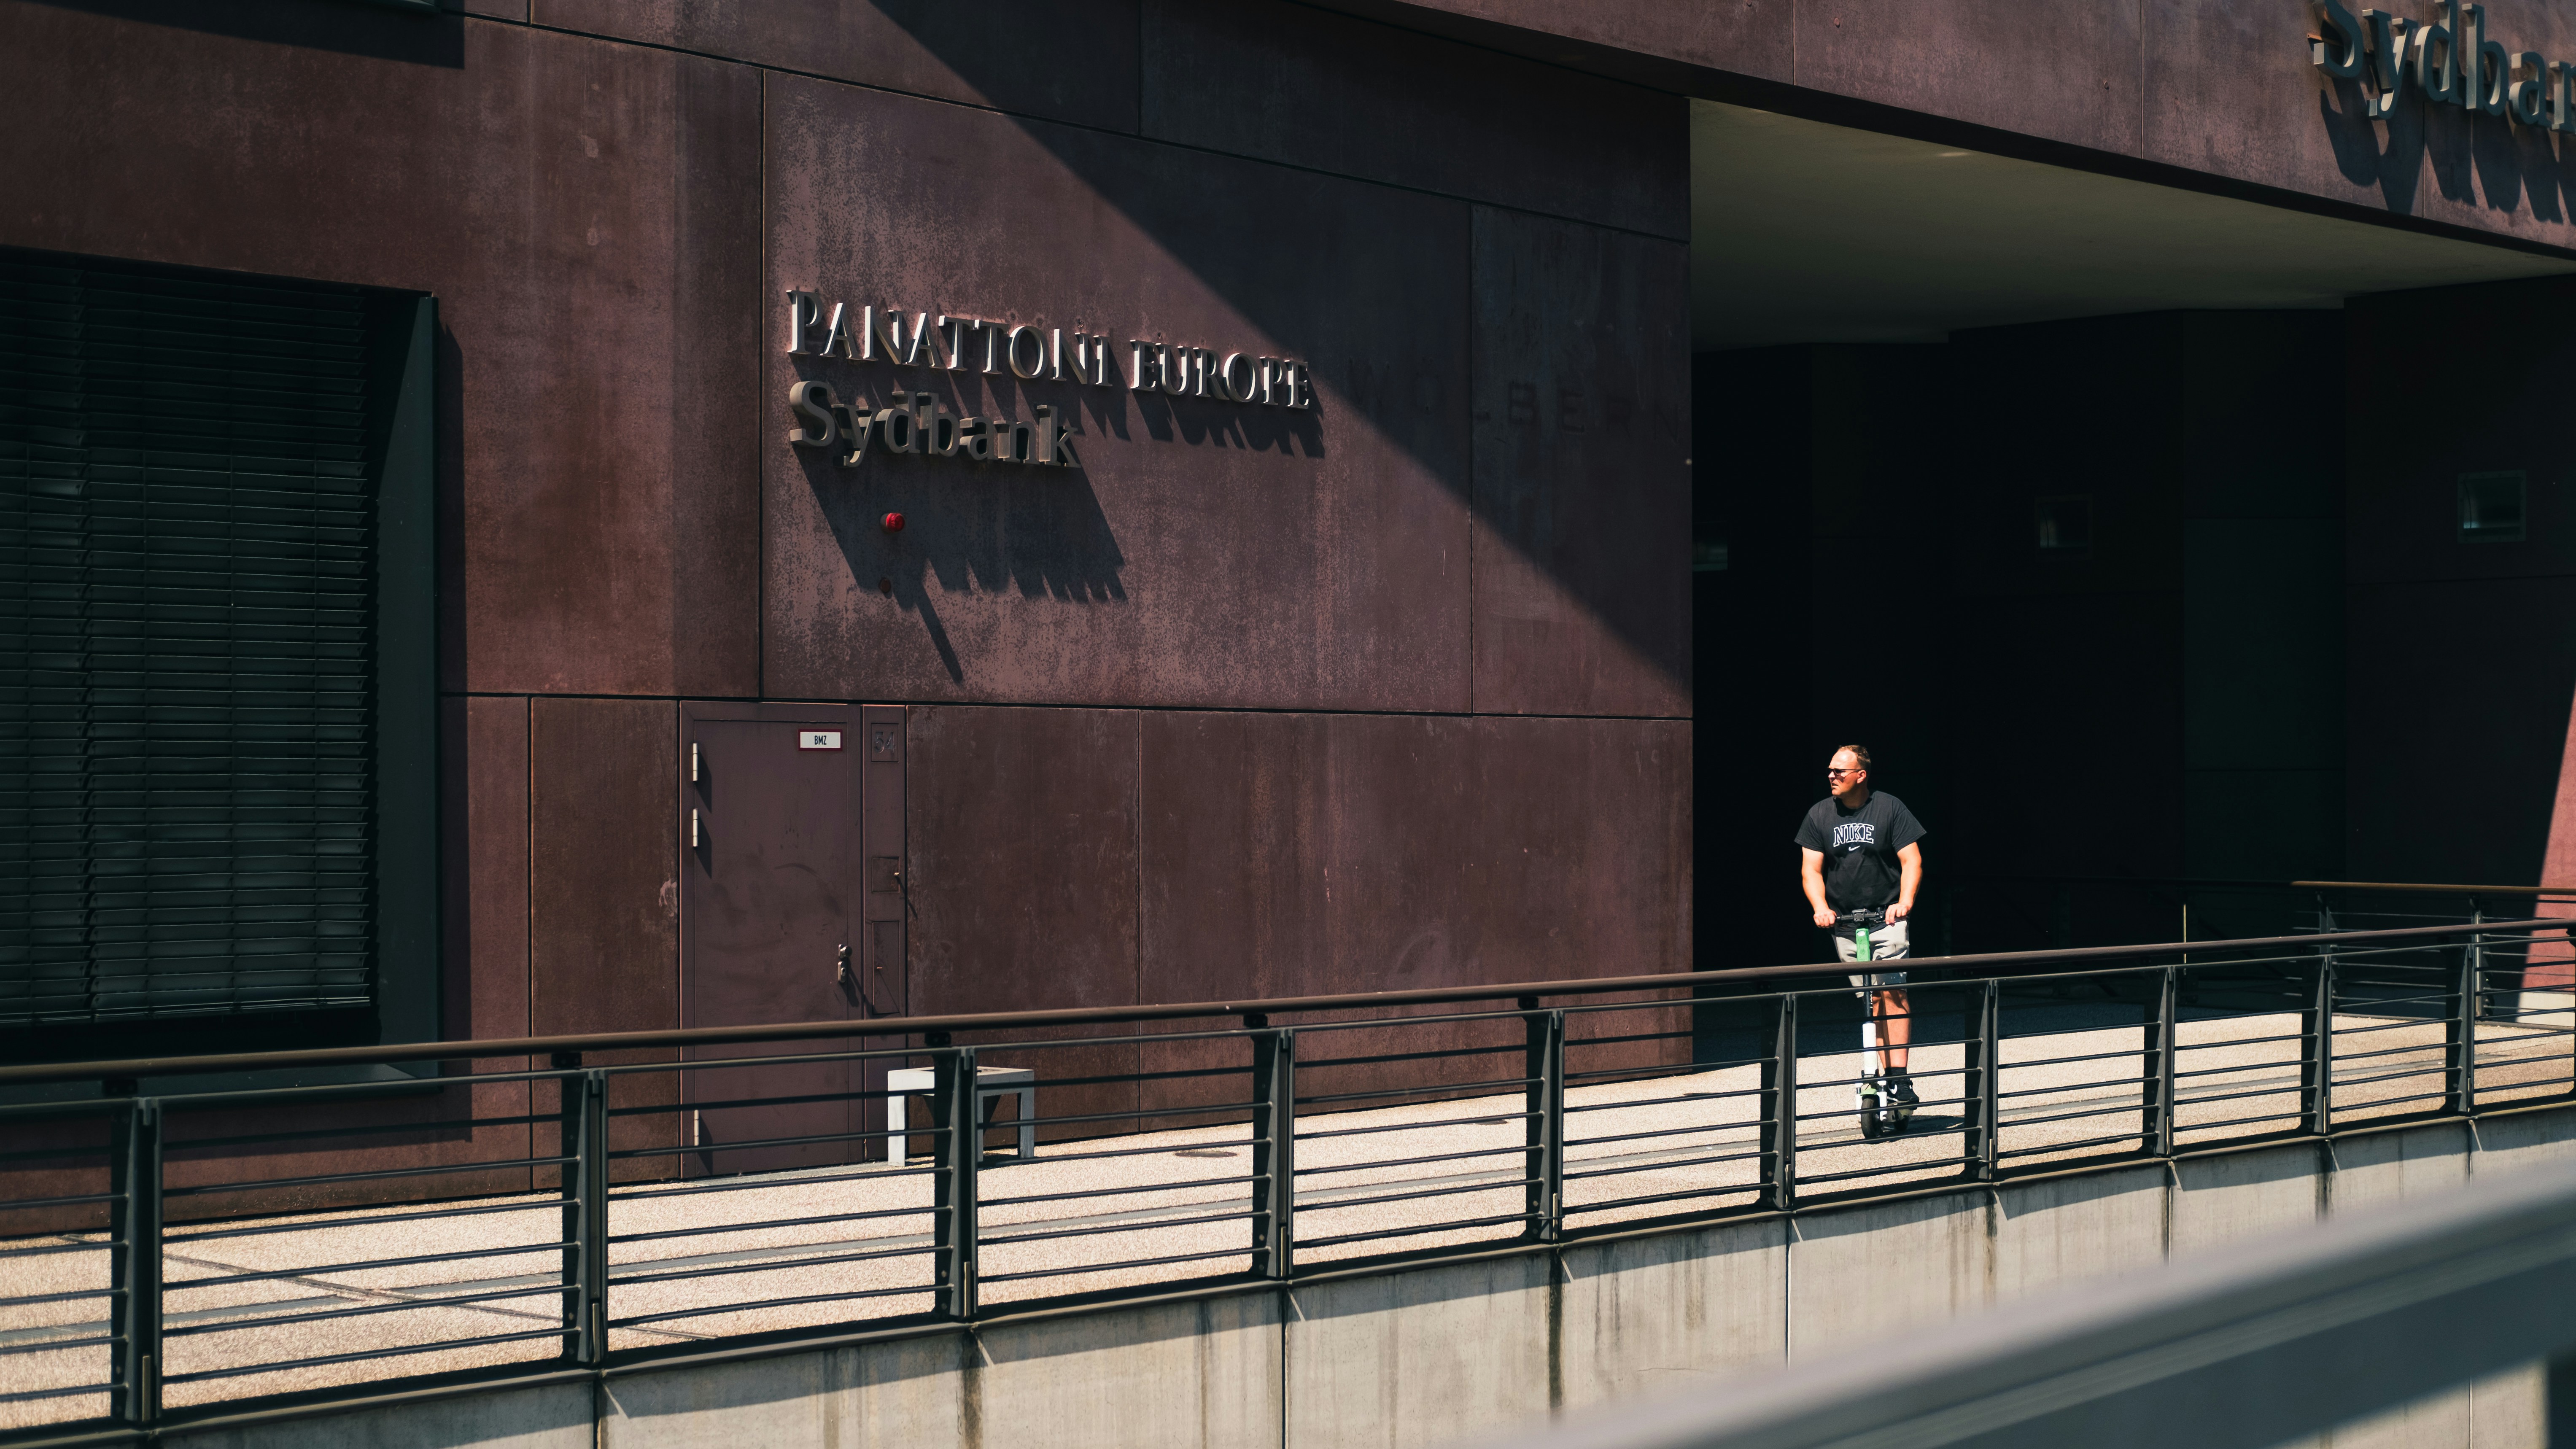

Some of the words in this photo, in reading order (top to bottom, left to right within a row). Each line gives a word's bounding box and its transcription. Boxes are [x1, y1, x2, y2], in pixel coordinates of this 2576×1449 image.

[787, 290, 1113, 387] PANATTONI
[1130, 339, 1309, 409] EUROPE
[790, 381, 1081, 467] Sydbank
[814, 735, 827, 745] BMZ
[874, 731, 896, 754] 54
[1833, 823, 1874, 847] NIKE
